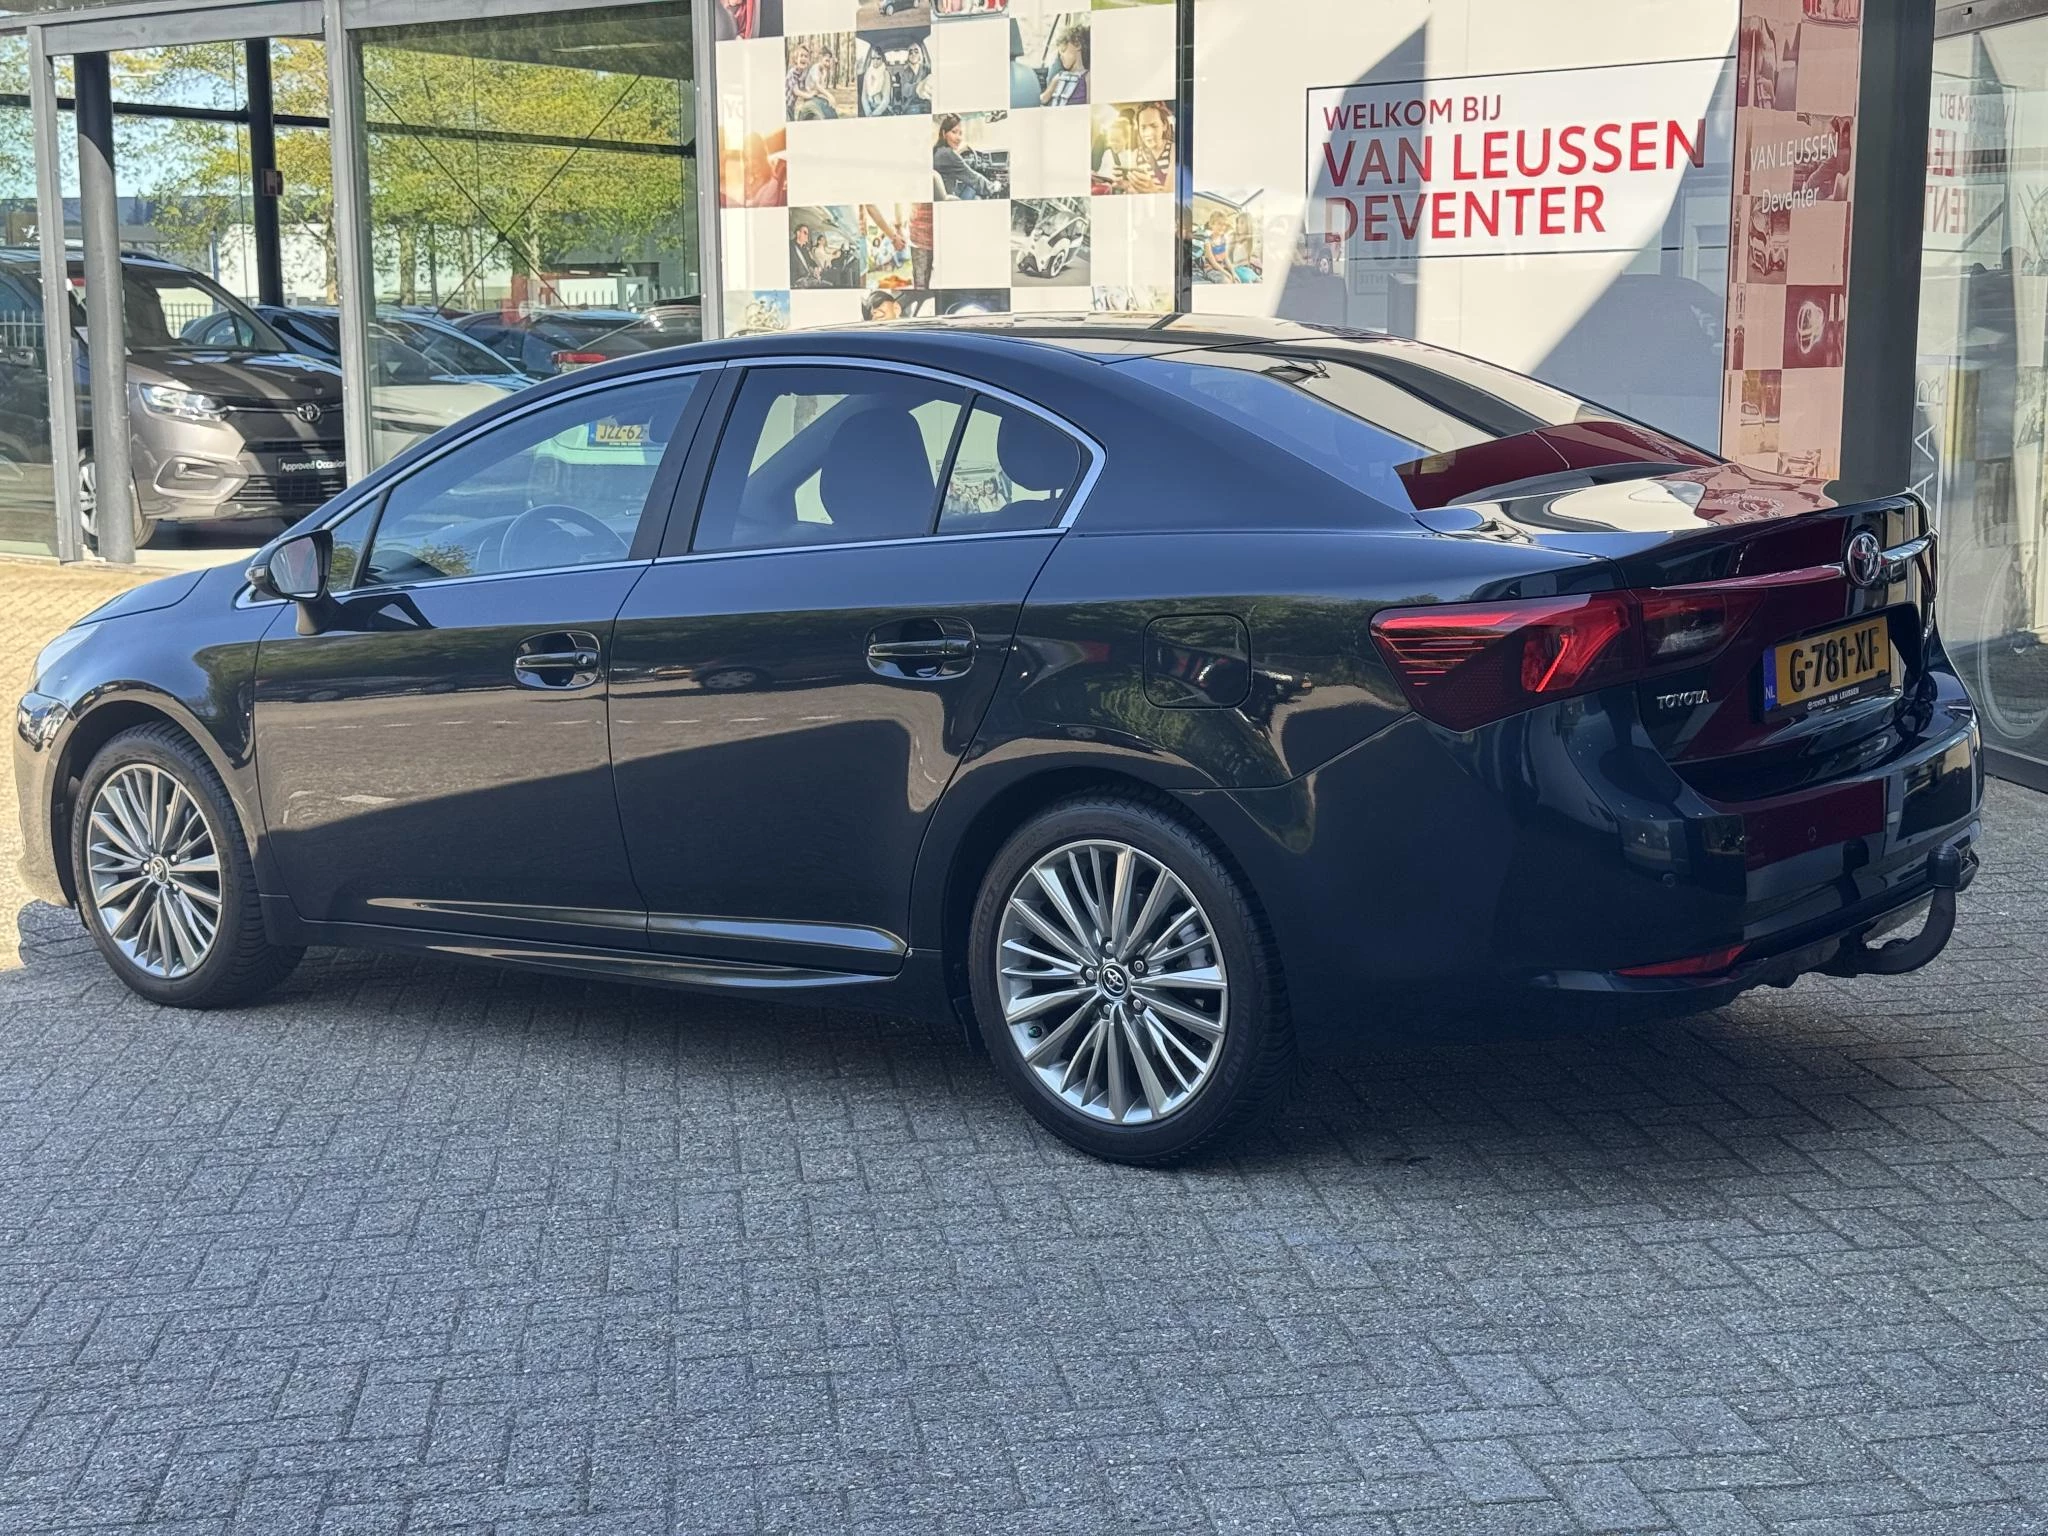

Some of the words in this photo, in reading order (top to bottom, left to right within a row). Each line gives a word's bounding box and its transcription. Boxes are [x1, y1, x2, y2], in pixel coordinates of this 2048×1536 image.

[1323, 98, 1453, 131] WELKOM
[1463, 94, 1501, 122] BIJ
[1323, 136, 1433, 187] VAN
[1453, 118, 1706, 180] LEUSSEN
[1750, 143, 1777, 172] VAN
[1779, 131, 1839, 167] LEUSSEN
[1325, 185, 1606, 243] DEVENTER
[1761, 186, 1820, 214] Deventer
[281, 462, 316, 472] Approved
[1789, 626, 1880, 693] G-781-XF
[1656, 689, 1710, 710] TOYOTA
[1765, 686, 1776, 699] NL
[1828, 694, 1838, 703] VAN
